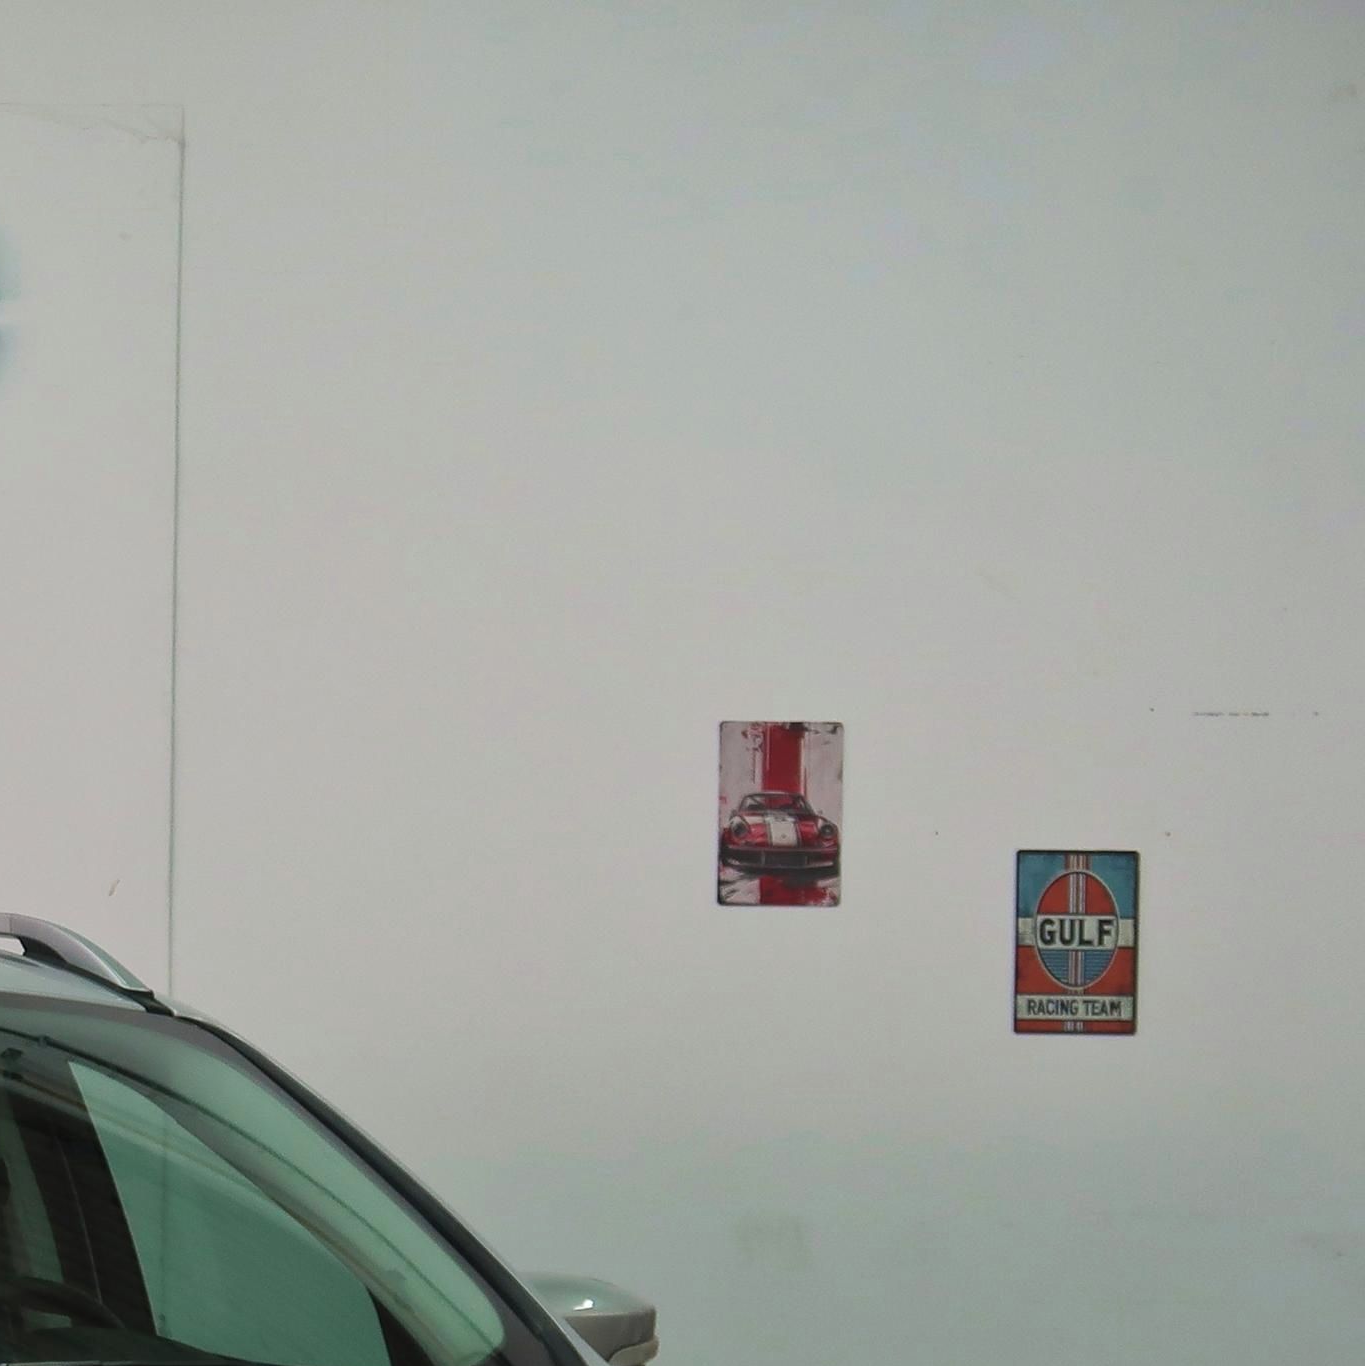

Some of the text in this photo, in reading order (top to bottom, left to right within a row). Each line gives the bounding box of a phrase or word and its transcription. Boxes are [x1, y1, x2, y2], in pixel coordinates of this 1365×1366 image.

[1039, 918, 1114, 947] GULF
[1027, 998, 1122, 1017] RACING TEAM
